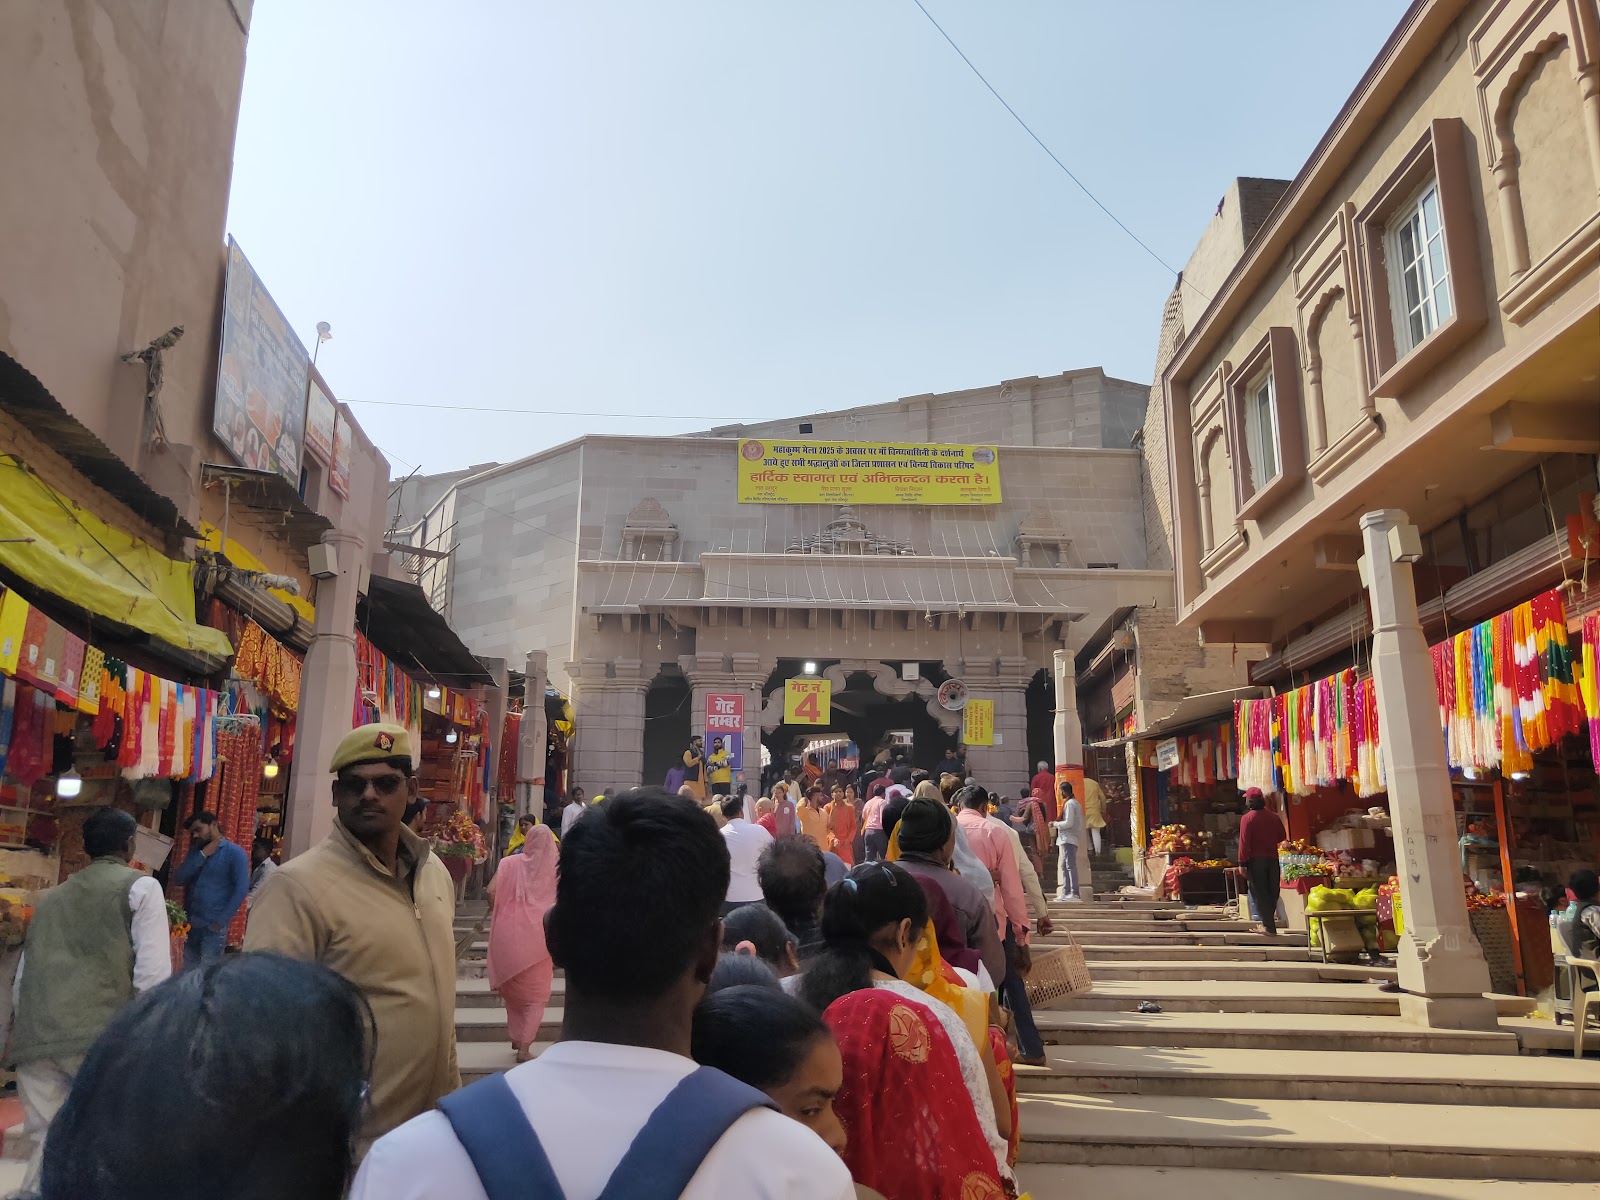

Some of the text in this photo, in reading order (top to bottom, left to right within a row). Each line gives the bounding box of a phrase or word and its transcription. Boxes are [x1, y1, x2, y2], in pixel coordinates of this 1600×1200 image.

[802, 445, 817, 454] मेला
[819, 446, 834, 455] 2025
[837, 446, 844, 455] के
[846, 447, 866, 455] अवसर
[868, 447, 876, 456] पर
[931, 448, 938, 457] के
[780, 459, 790, 468] हुए
[791, 458, 805, 467] सभी
[841, 459, 850, 468] का
[852, 458, 870, 468] जिला
[871, 460, 896, 468] प्रशासन
[898, 459, 908, 468] एवं
[930, 460, 952, 469] विकास
[749, 469, 789, 483] हार्दिक
[793, 473, 836, 483] स्वागत
[839, 472, 858, 483] एवं
[862, 471, 931, 484] अभिनन्दन
[934, 475, 970, 484] करता
[791, 681, 809, 692] गेट
[715, 697, 735, 713] गेट
[795, 693, 820, 722] 4
[709, 714, 741, 728] नम्बर
[722, 734, 735, 758] 1
